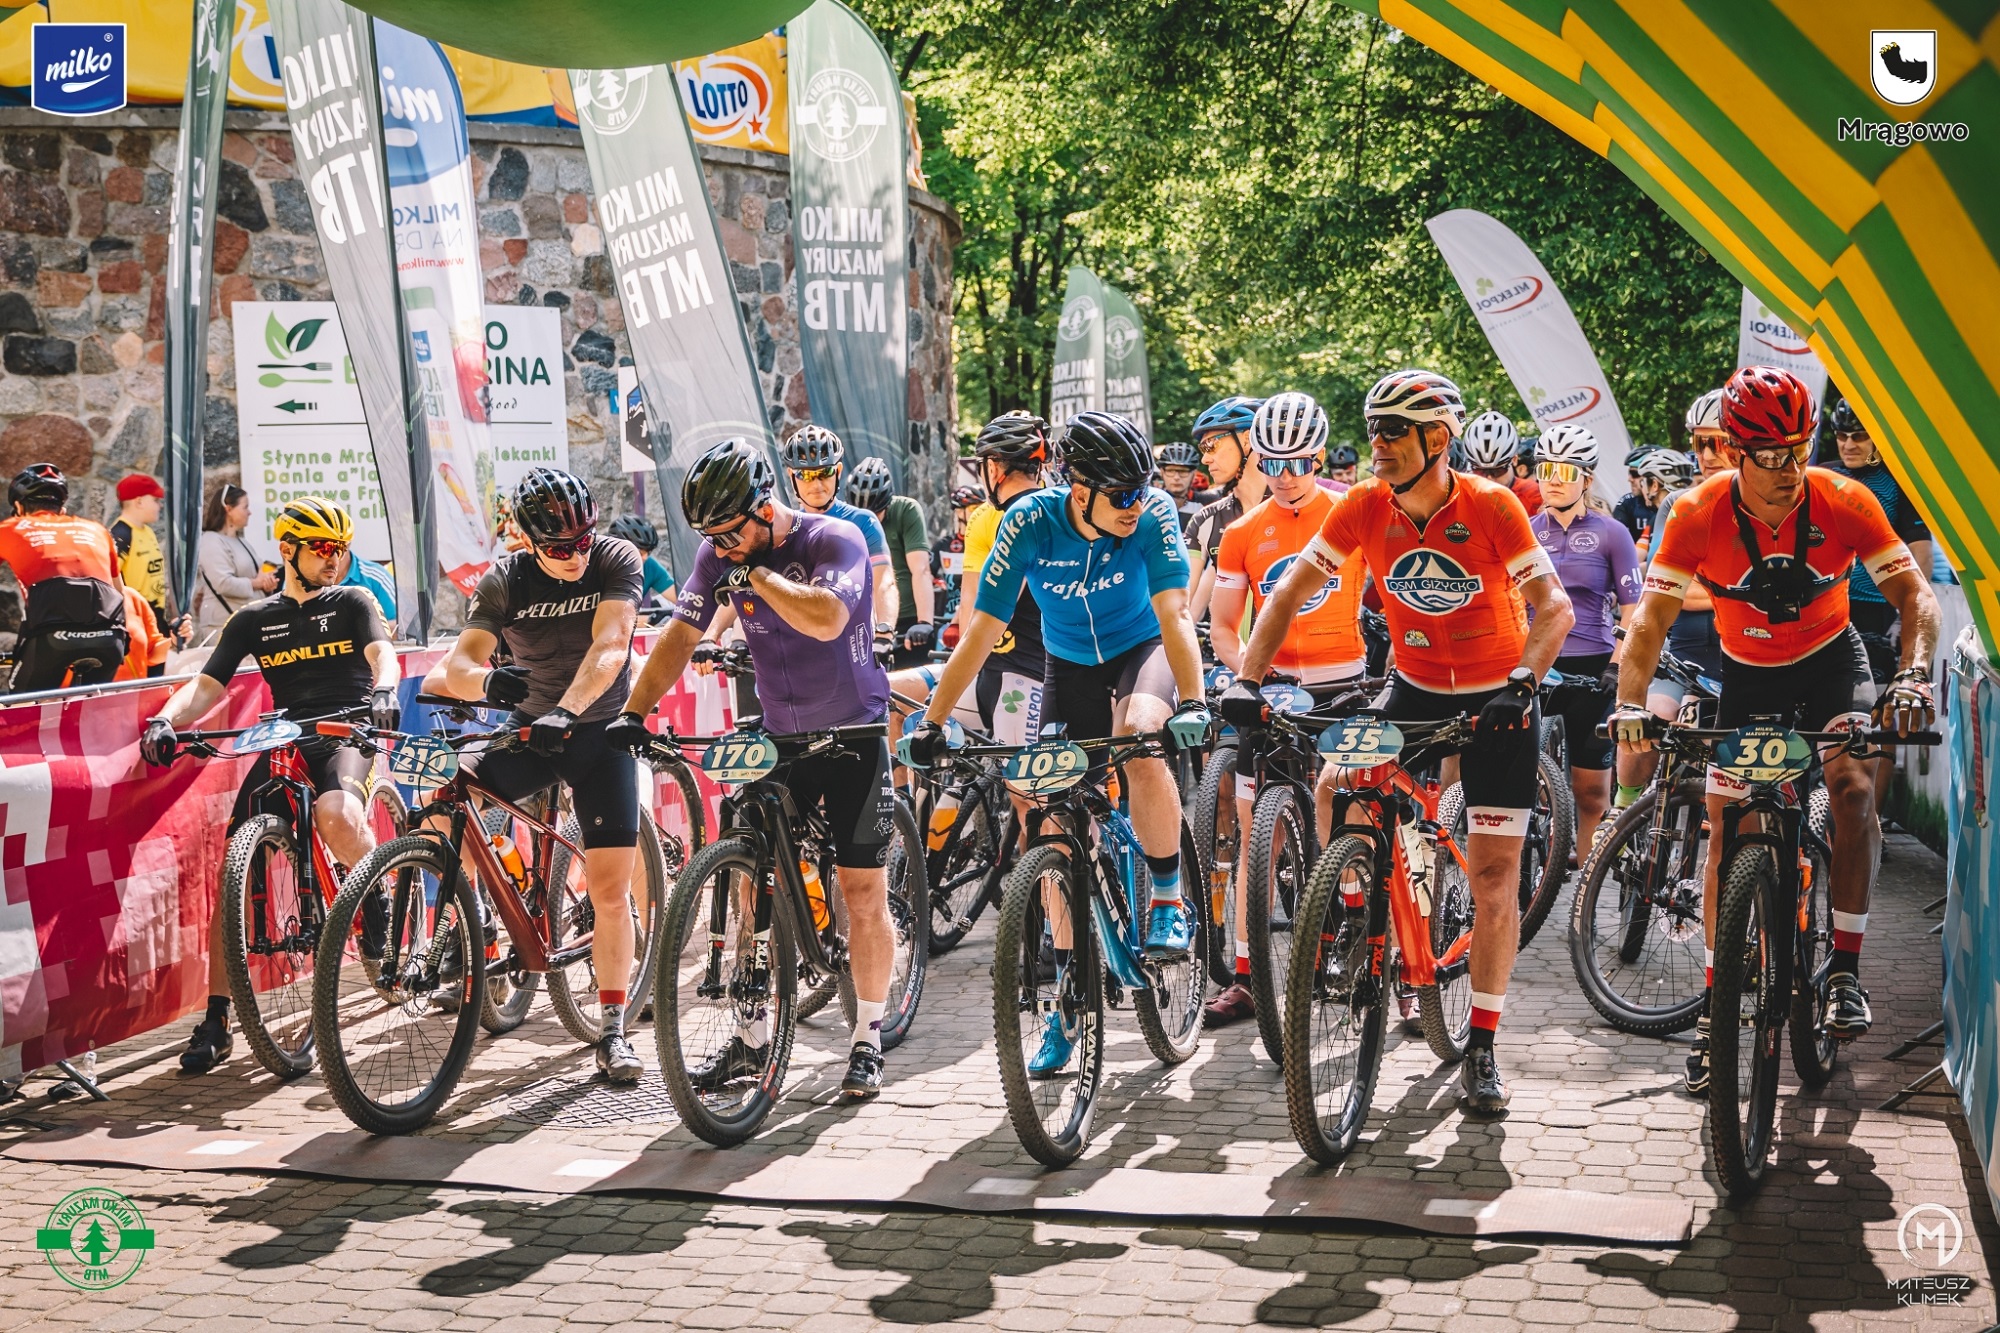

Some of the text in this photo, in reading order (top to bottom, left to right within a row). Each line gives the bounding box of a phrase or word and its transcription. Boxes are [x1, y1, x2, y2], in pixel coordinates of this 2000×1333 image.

[688, 78, 748, 120] LOTTO
[262, 449, 332, 469] Słynne
[264, 467, 324, 485] Dania
[985, 506, 1044, 587] rafbike.pl
[1042, 572, 1125, 600] rafbike
[1389, 578, 1478, 592] OSM GIŻYCKO
[66, 630, 114, 639] KROSS
[260, 640, 354, 669] EVANLITE
[240, 724, 292, 747] 149
[1335, 728, 1384, 752] 35
[396, 746, 448, 774] 210
[711, 743, 767, 769] 170
[1017, 750, 1077, 778] 109
[1734, 738, 1788, 766] 30
[427, 917, 451, 967] ROCKSHOX
[755, 941, 769, 970] FOX
[774, 993, 797, 1089] SCHWALBE
[1080, 1011, 1097, 1100] EVANLITE
